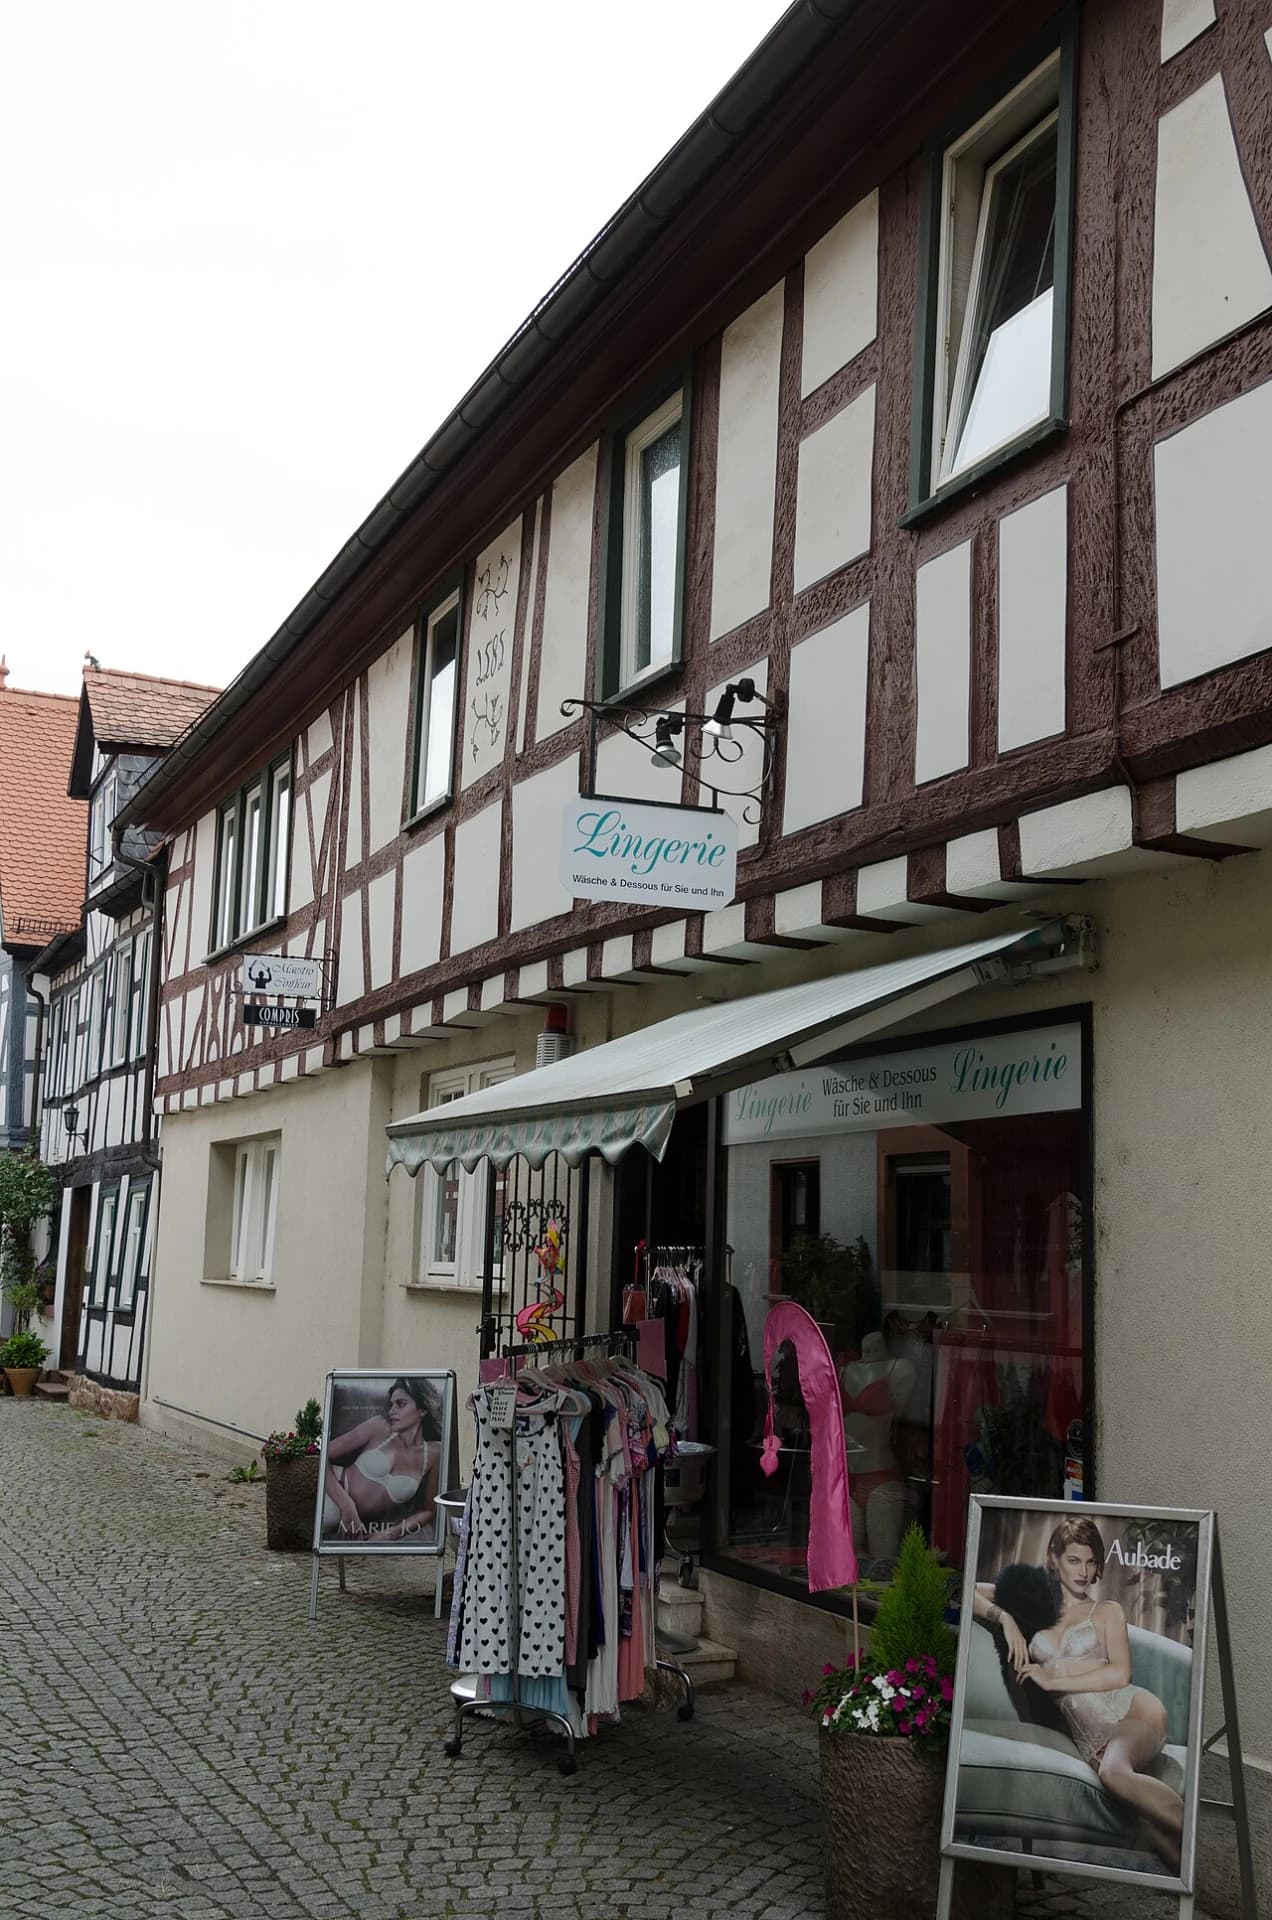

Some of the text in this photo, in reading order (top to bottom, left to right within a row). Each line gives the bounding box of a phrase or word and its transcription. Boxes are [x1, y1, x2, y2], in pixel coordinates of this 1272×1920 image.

[573, 810, 726, 875] Lingerie
[572, 874, 725, 897] Wäsche & Dessous für Sie und Ihn
[259, 1007, 300, 1024] COMPRIS
[822, 1066, 937, 1097] Wäsche & Dessous
[951, 1042, 1069, 1110] Lingerie
[735, 1081, 813, 1136] Lingerie
[833, 1092, 922, 1118] für Sie und Ihn
[338, 1518, 421, 1537] MARIE JO
[1104, 1538, 1182, 1571] Aubade
